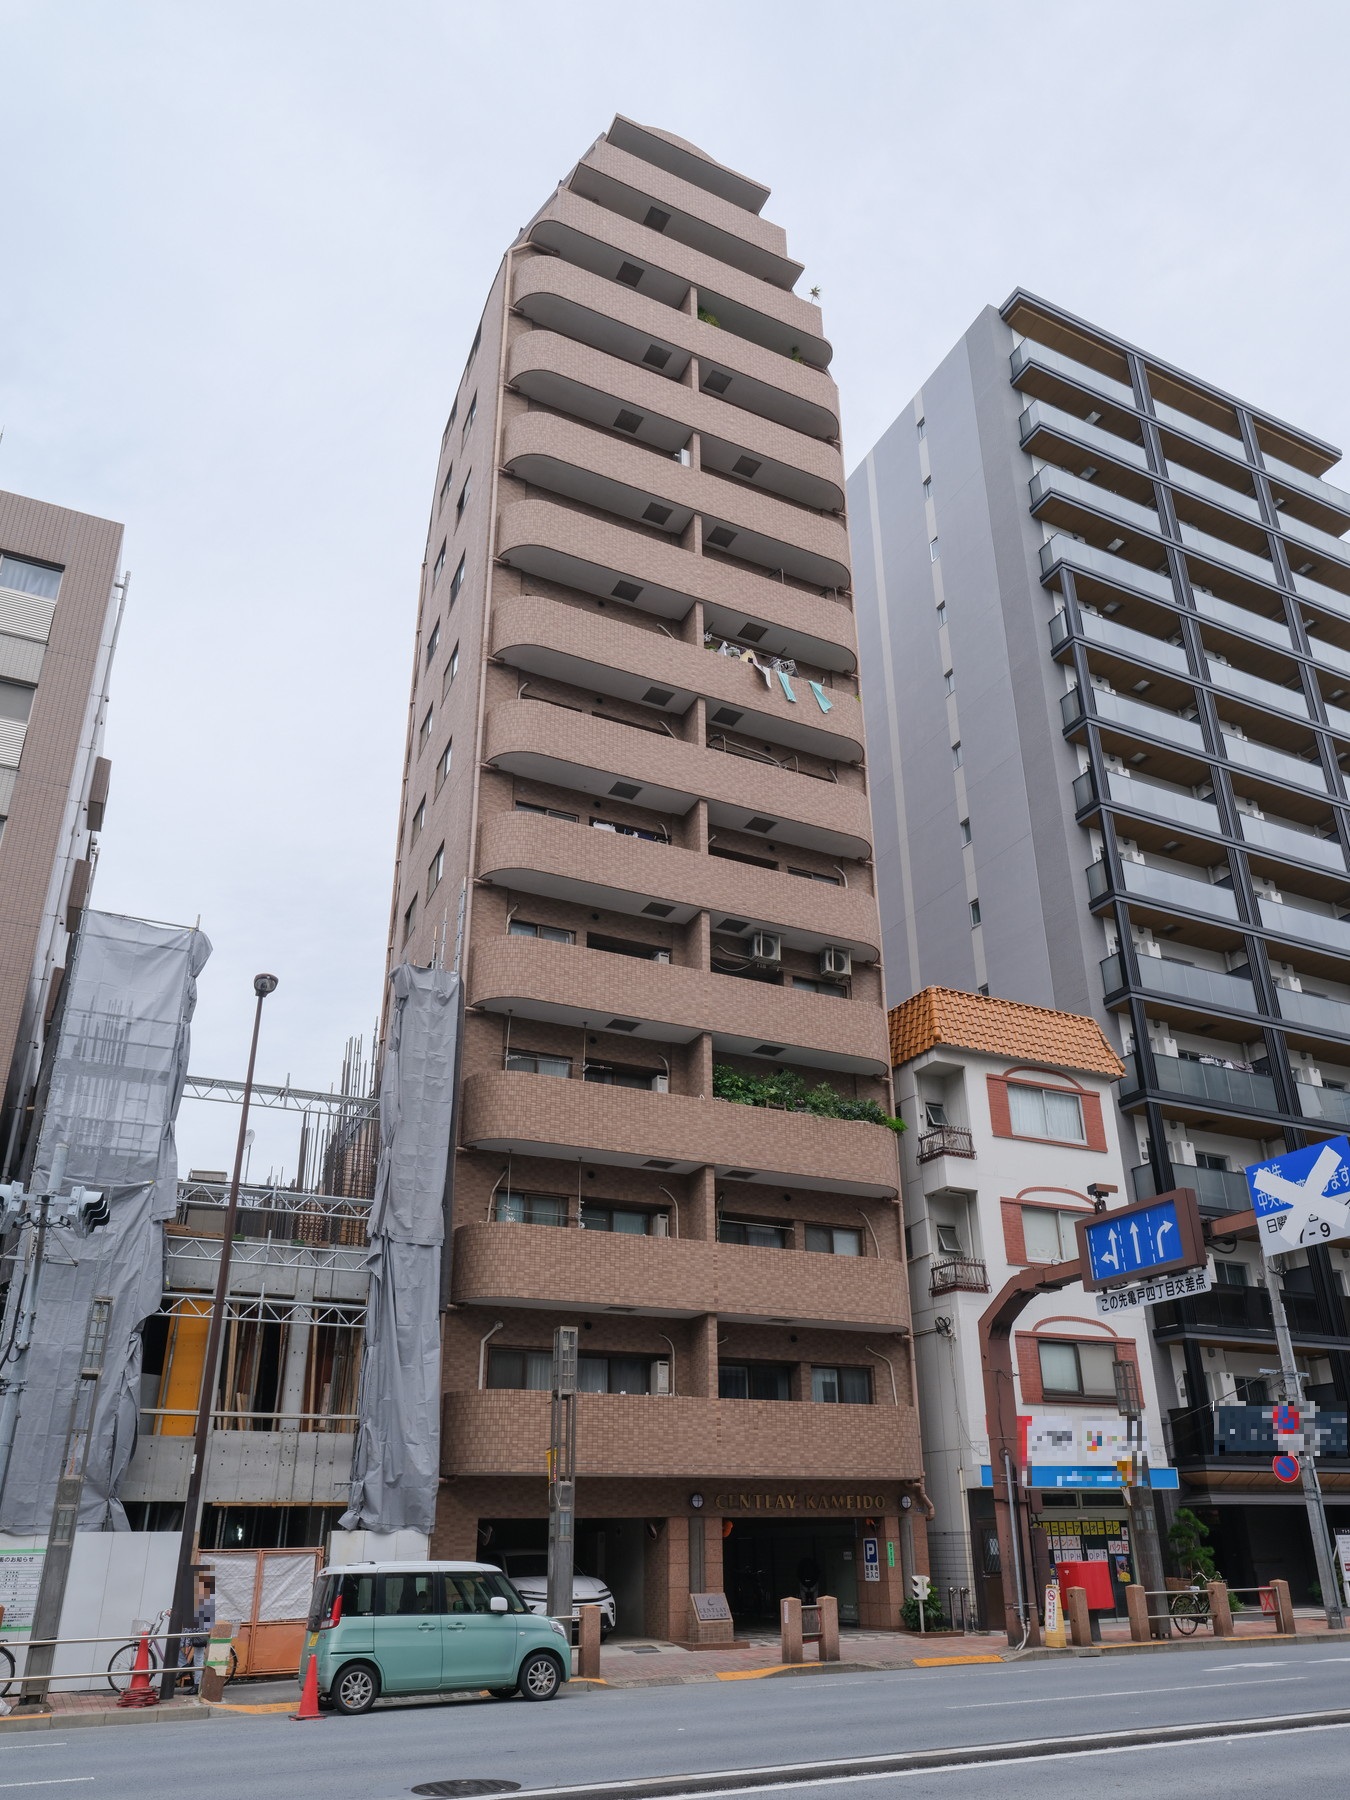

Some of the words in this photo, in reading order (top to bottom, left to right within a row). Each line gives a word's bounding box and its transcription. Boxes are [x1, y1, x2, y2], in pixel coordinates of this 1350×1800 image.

[1101, 1274, 1206, 1311] この先亀戸四丁目交差点
[715, 1494, 796, 1509] CENTLAY
[806, 1494, 886, 1509] KAMEIDO
